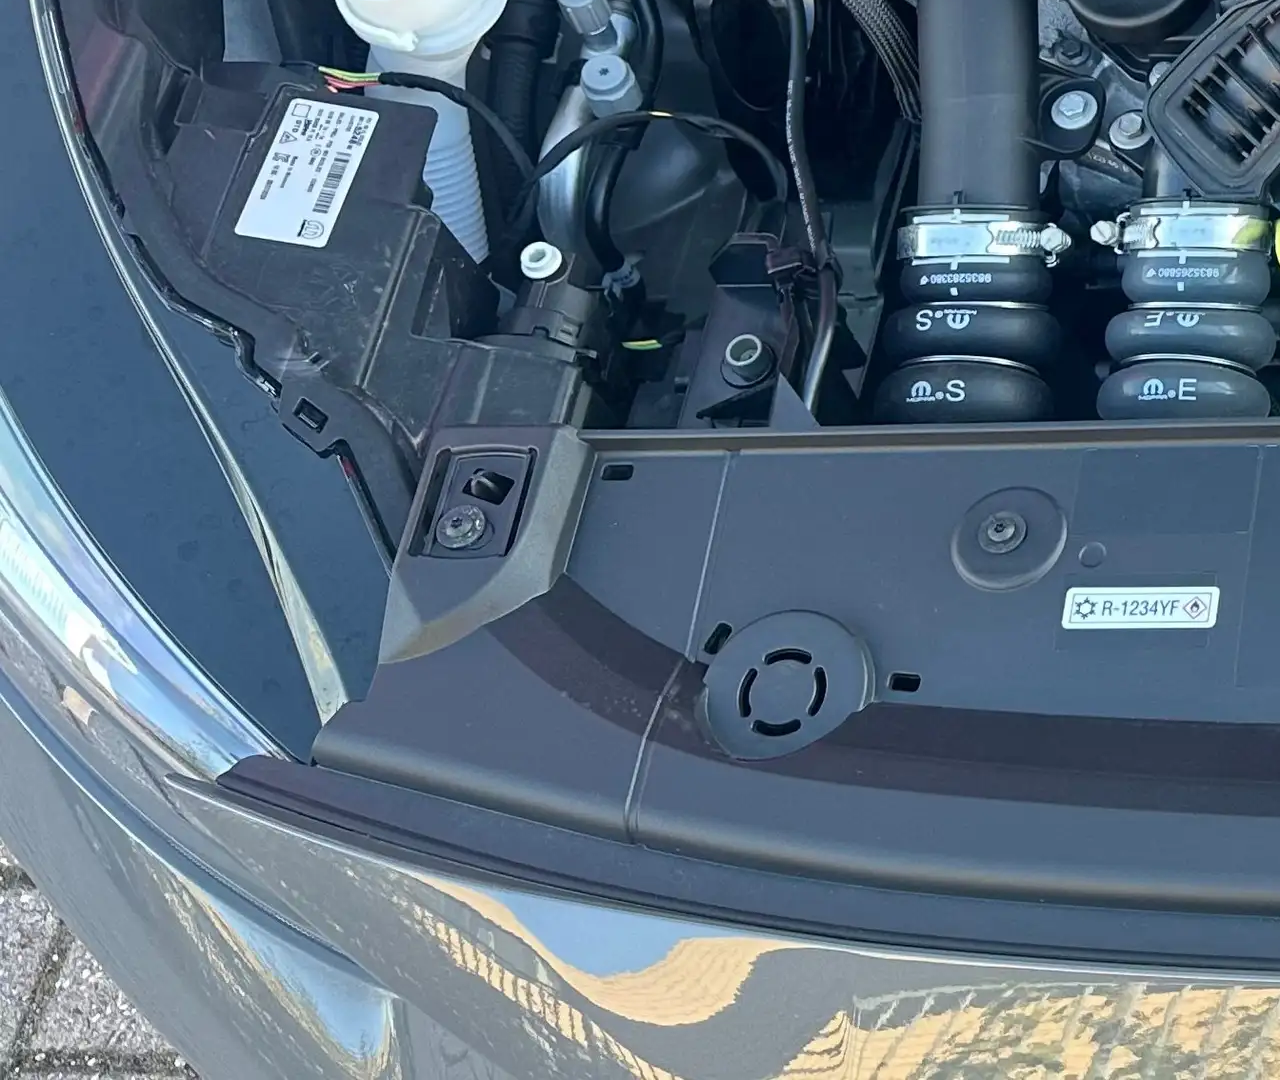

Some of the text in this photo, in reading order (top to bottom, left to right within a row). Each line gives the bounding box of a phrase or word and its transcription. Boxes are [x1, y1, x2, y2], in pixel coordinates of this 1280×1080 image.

[945, 379, 966, 402] S
[1178, 378, 1197, 401] E
[1101, 599, 1180, 617] R-1234YF
